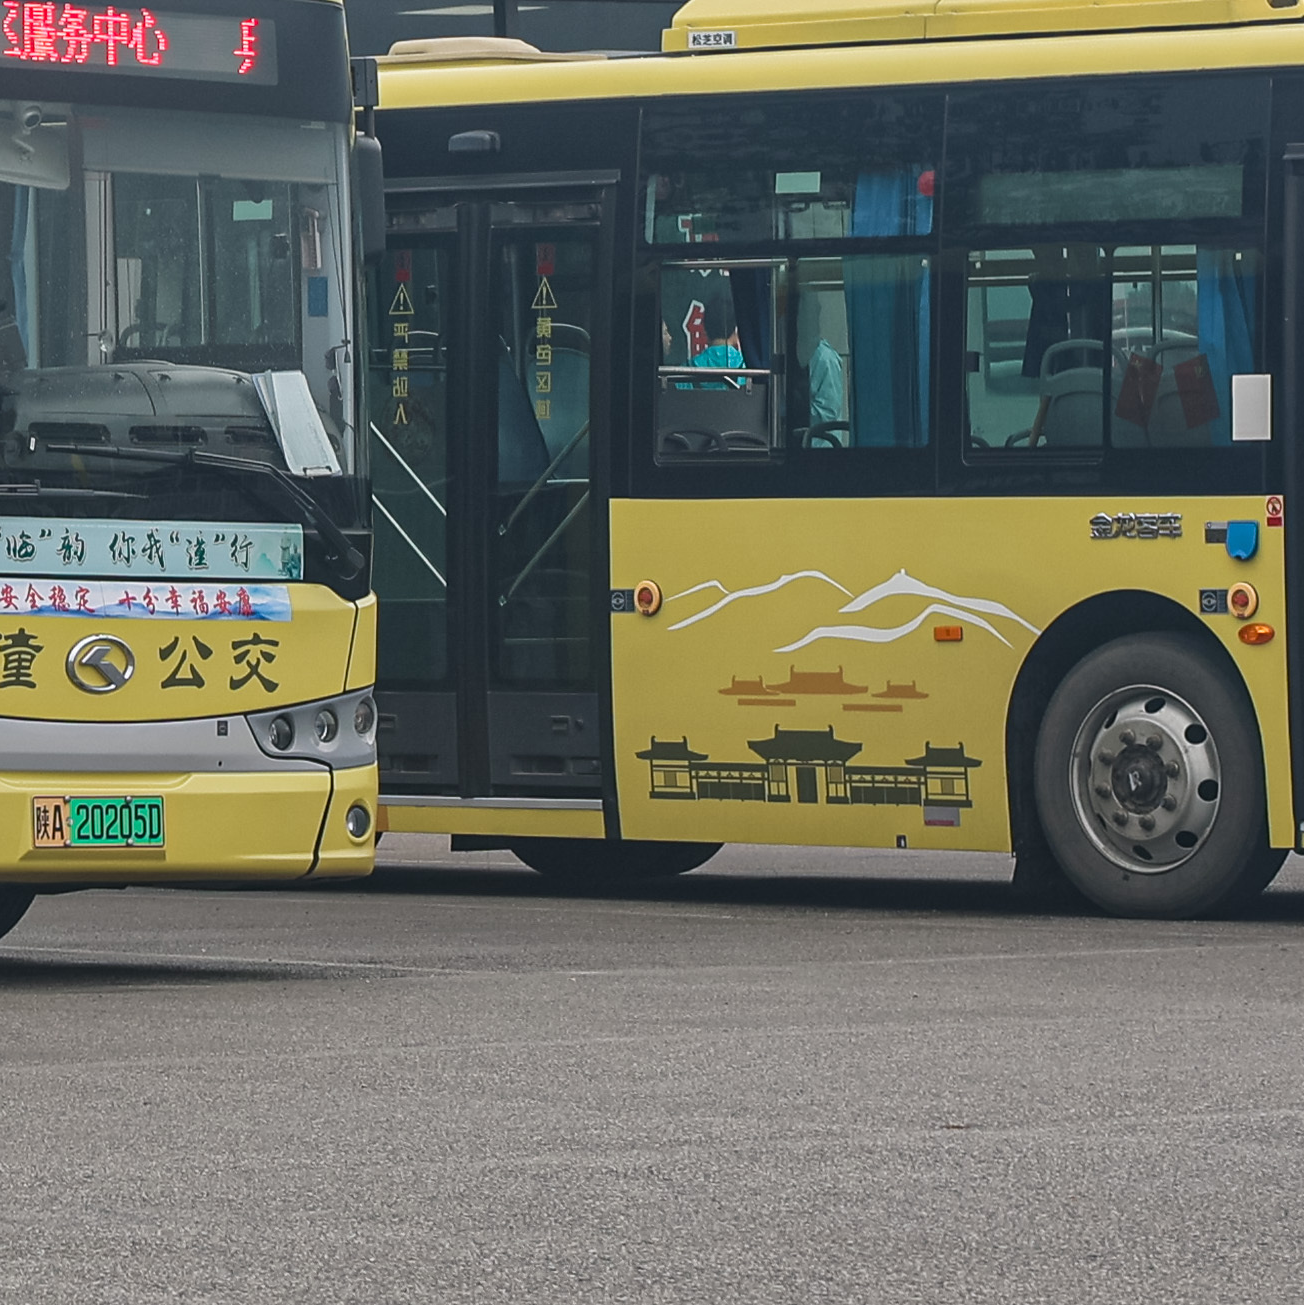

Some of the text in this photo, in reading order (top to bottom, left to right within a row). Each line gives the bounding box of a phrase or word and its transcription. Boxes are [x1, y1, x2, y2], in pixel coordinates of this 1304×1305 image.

[1089, 512, 1183, 539] 金龙客车
[158, 634, 280, 693] 公交
